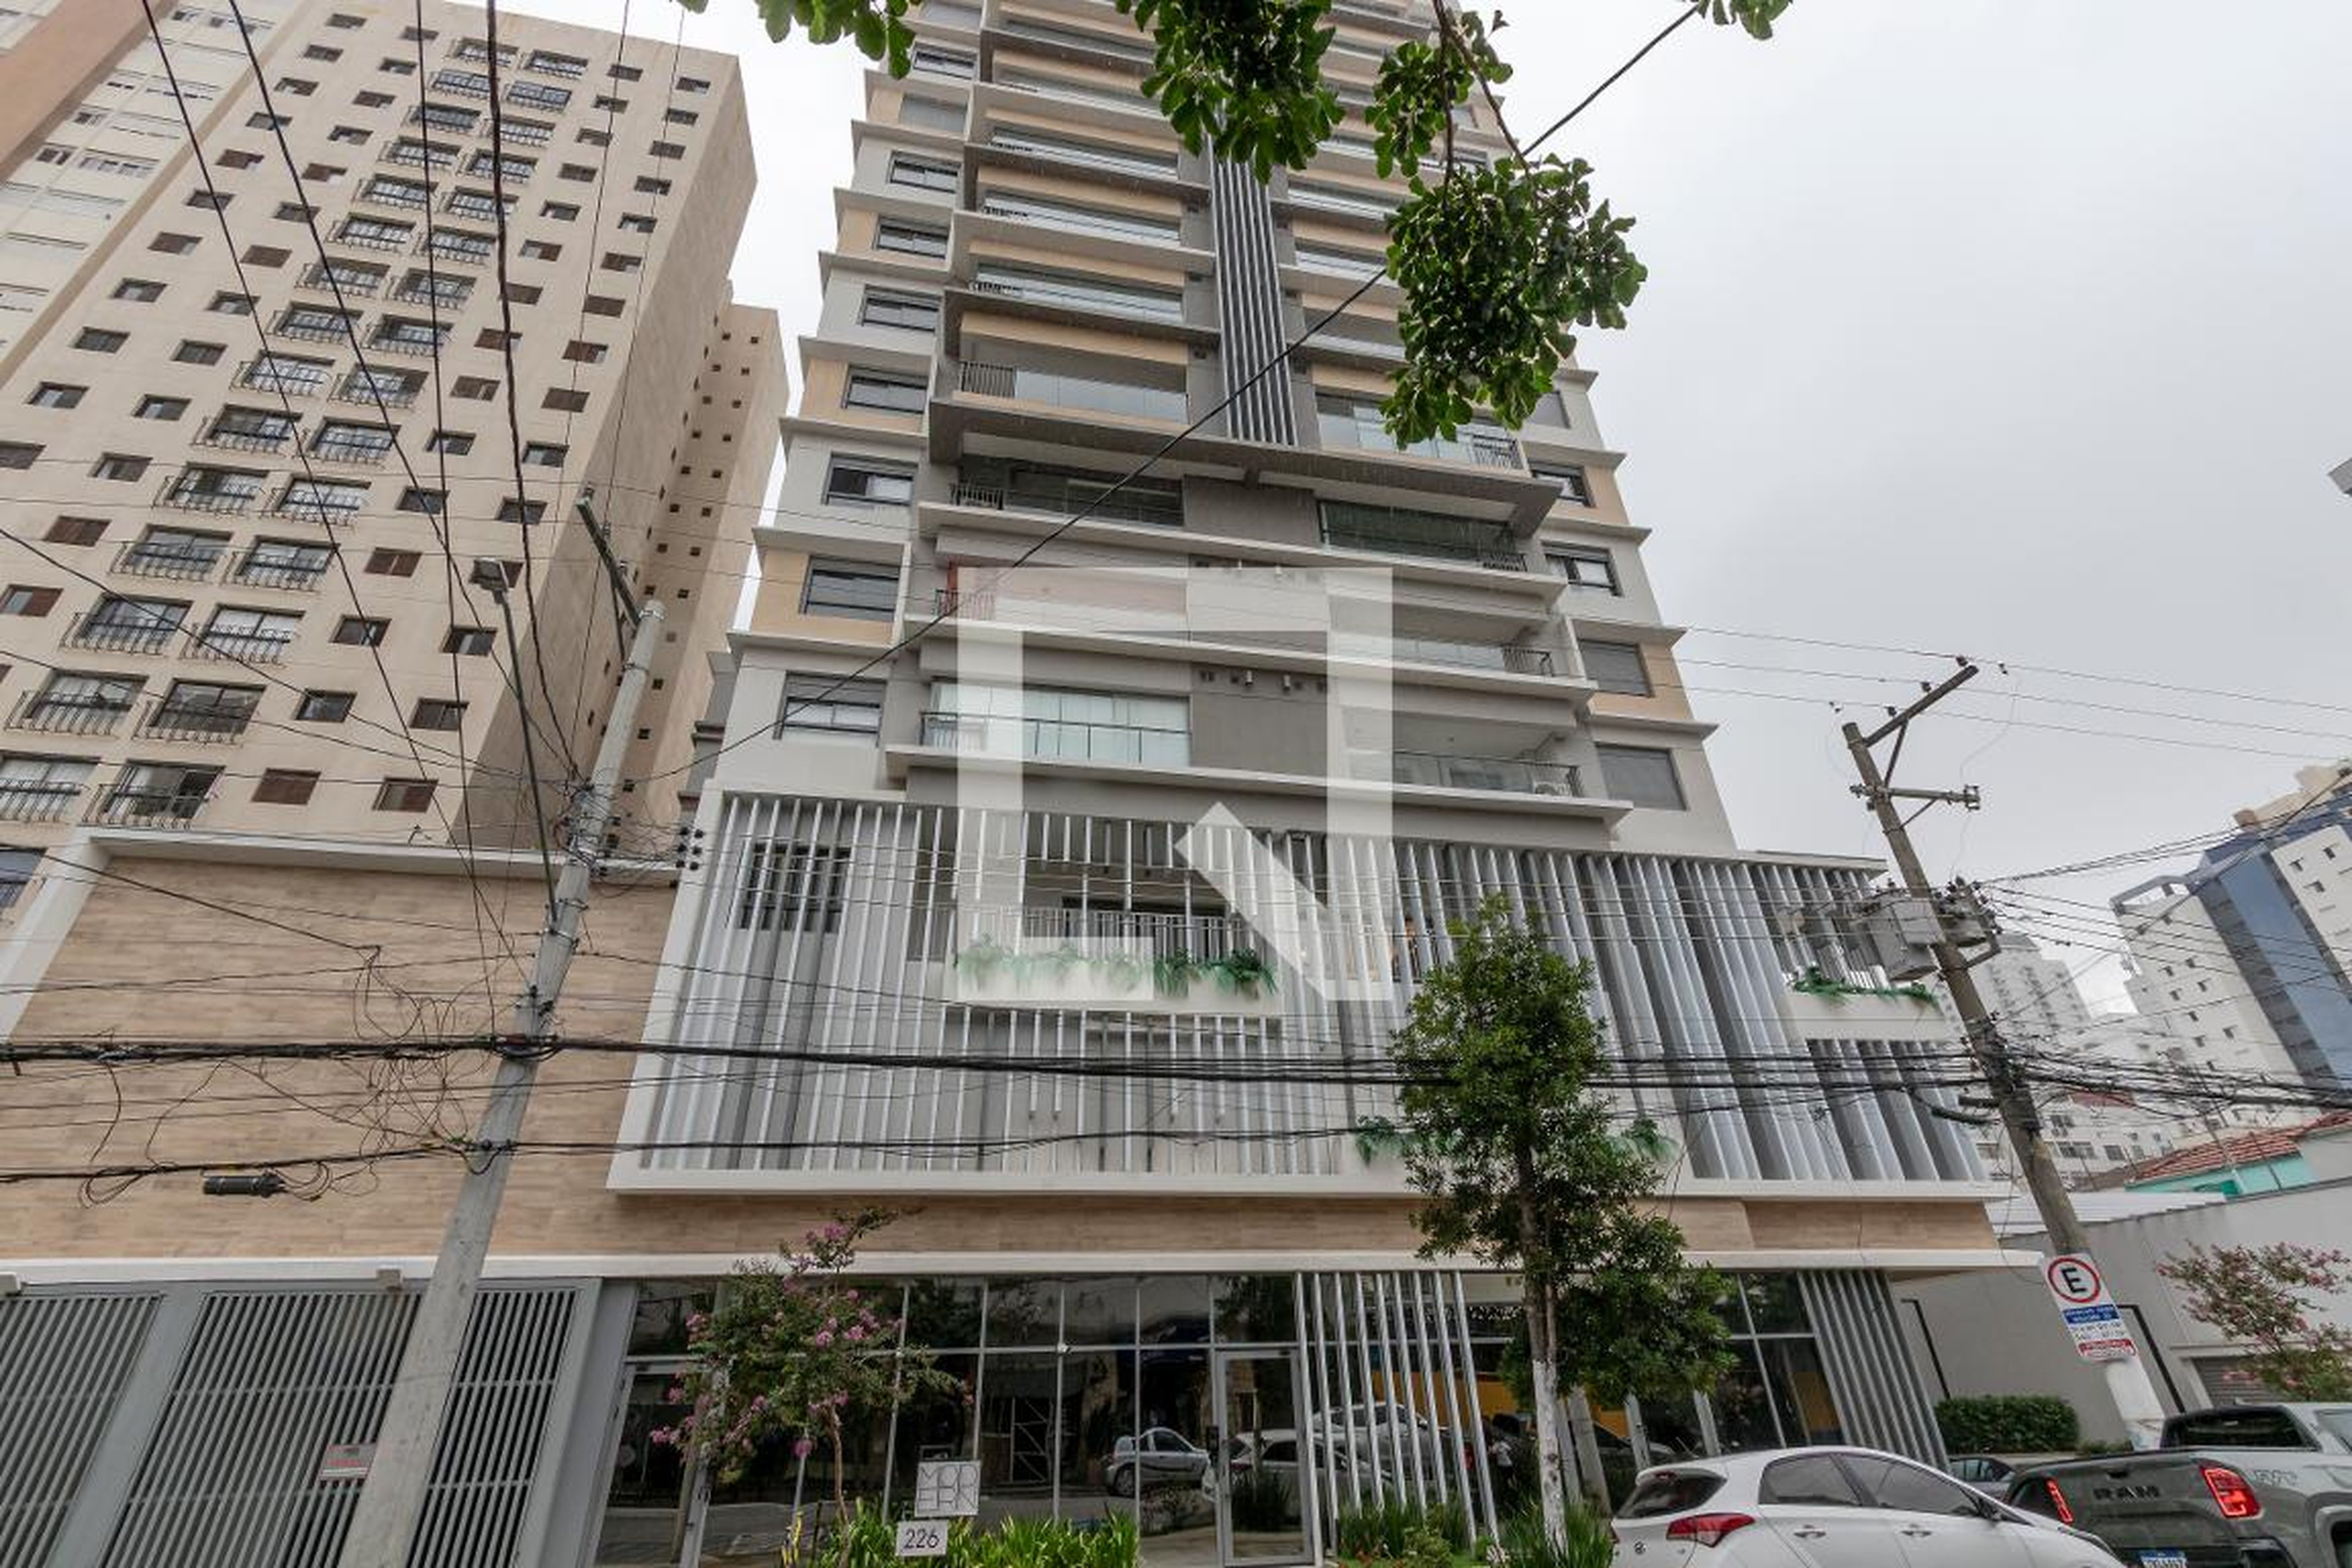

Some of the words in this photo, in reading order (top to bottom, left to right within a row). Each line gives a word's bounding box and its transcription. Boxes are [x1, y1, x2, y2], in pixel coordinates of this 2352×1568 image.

[2061, 1267, 2087, 1293] E
[2094, 1486, 2160, 1500] RAM
[903, 1529, 940, 1548] 226
